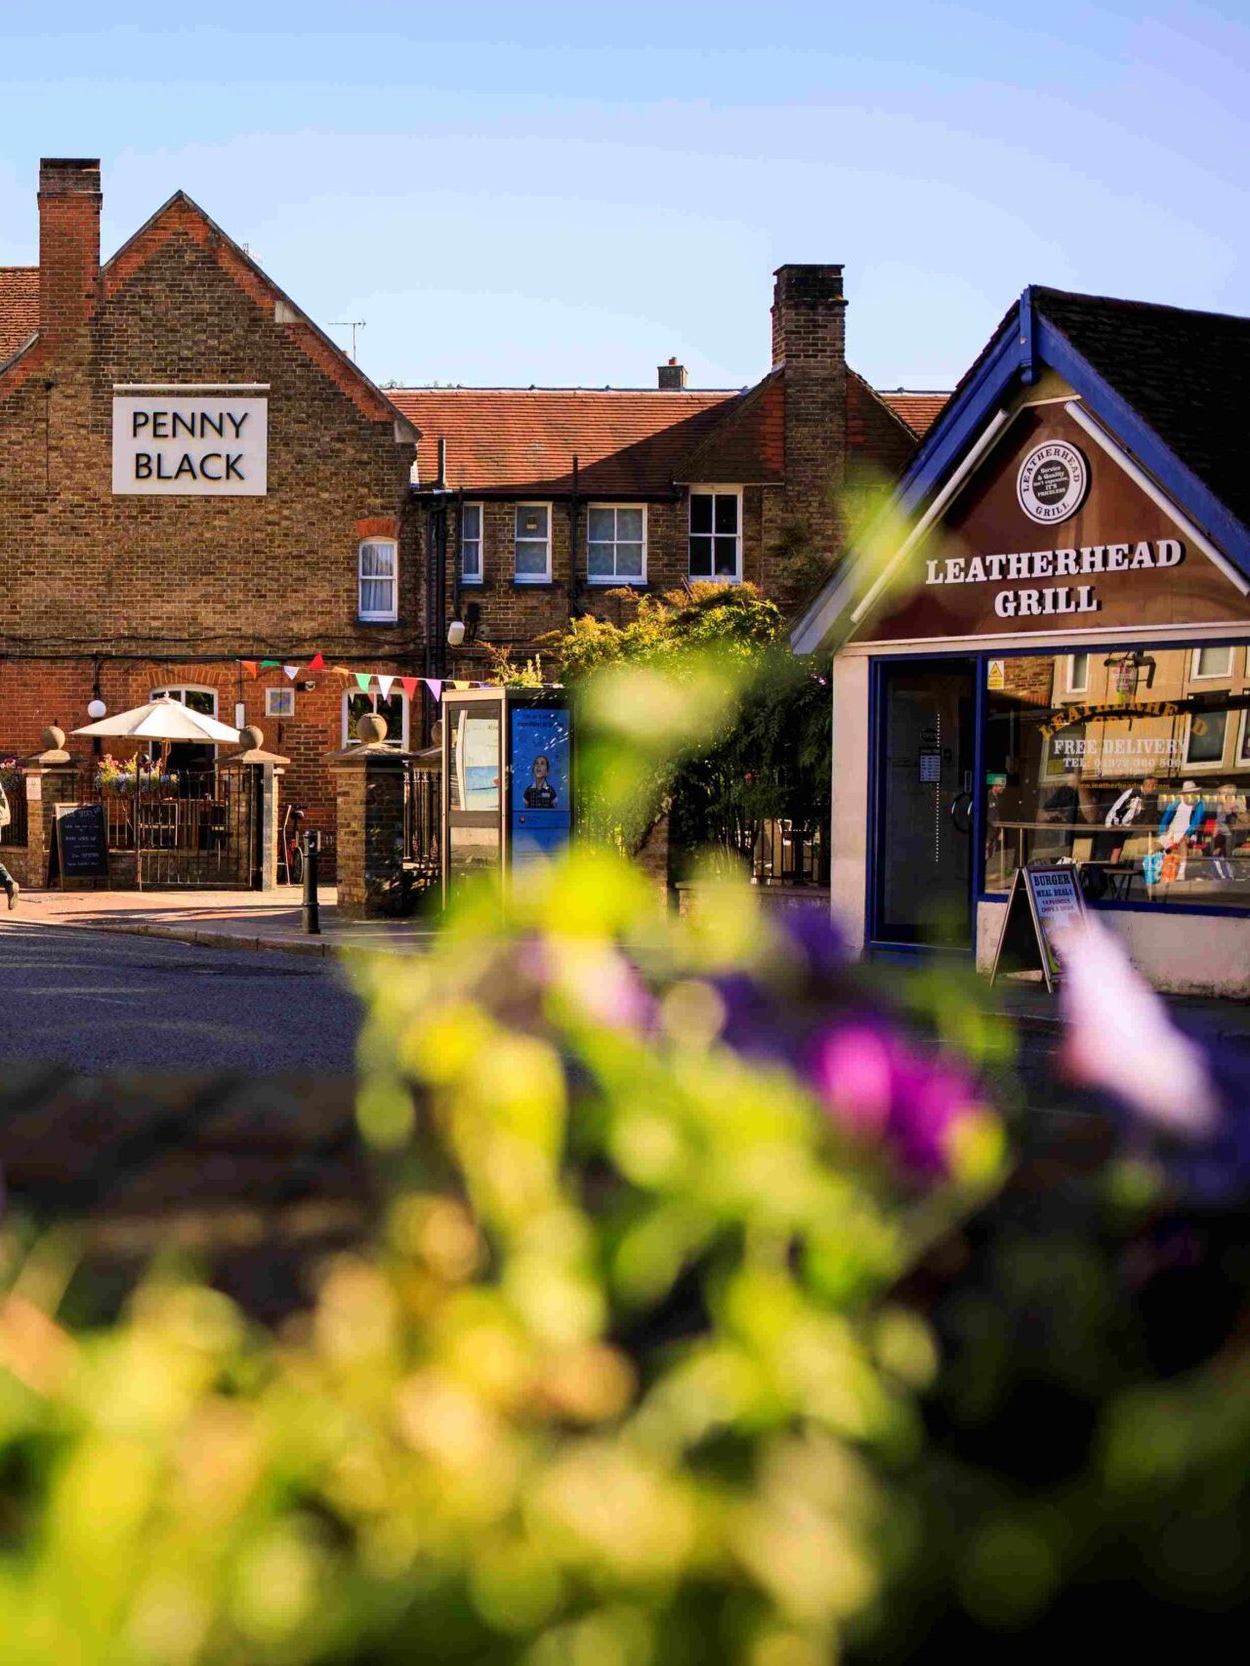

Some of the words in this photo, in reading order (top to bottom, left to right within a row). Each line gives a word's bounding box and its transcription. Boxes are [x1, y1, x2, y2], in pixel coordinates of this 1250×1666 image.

[132, 411, 249, 439] PENNY
[135, 452, 245, 480] BLACK
[1023, 447, 1080, 492] LEATHERHEAD
[1040, 466, 1061, 474] Service
[1043, 471, 1065, 479] Quality
[1035, 502, 1070, 517] GRILL
[925, 539, 1184, 585] LEATHERHEAD
[994, 585, 1100, 618] GRILL
[1038, 699, 1209, 742] LEATHERHED
[1053, 739, 1099, 755] FREE
[1103, 738, 1187, 755] DELIVERY
[1033, 874, 1071, 886] BURGER
[1036, 889, 1052, 897] MEAL
